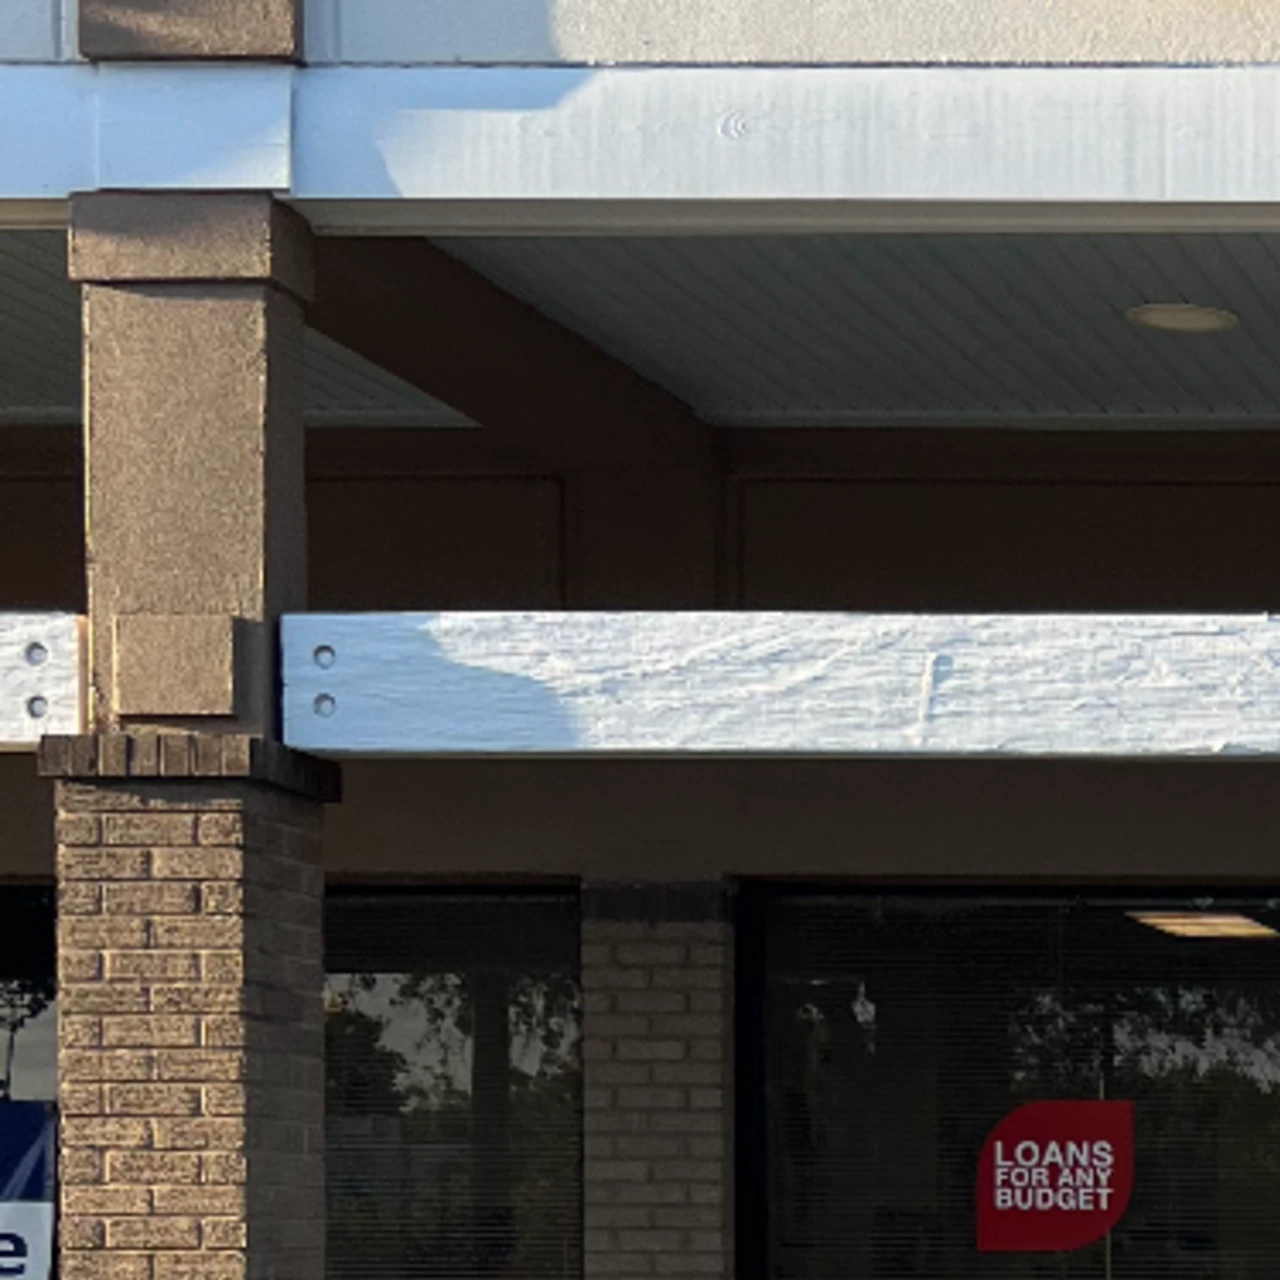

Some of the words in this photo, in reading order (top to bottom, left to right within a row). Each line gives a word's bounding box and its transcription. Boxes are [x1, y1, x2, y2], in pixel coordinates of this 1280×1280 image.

[995, 1140, 1114, 1167] LOANS
[996, 1167, 1049, 1187] FOR
[1058, 1167, 1113, 1187] ANY
[995, 1188, 1114, 1211] BUDGET
